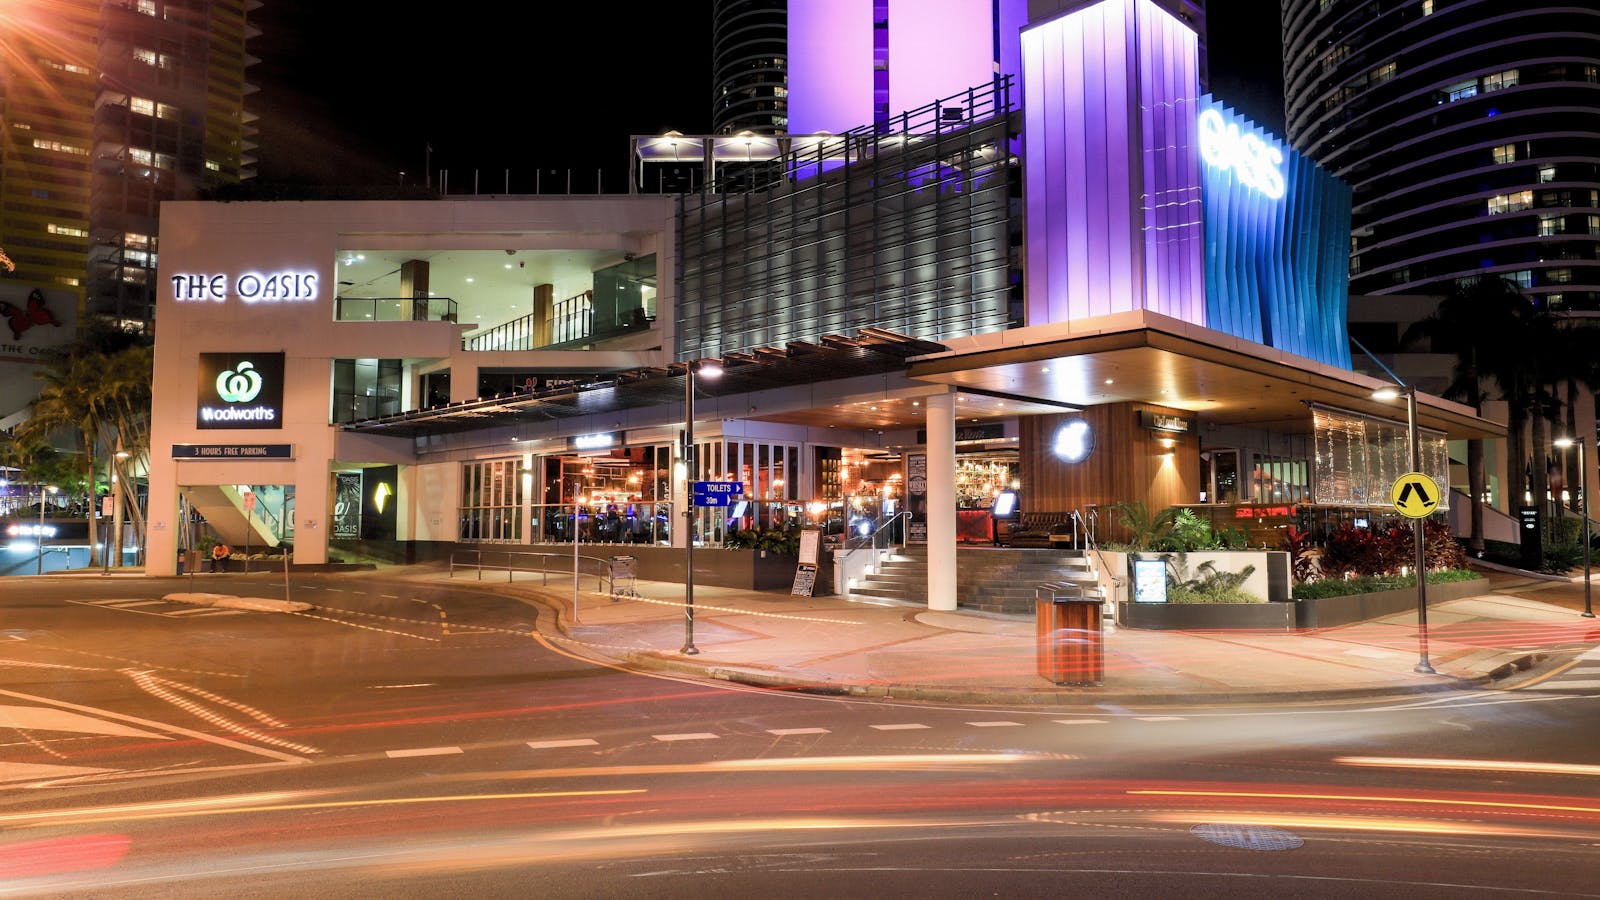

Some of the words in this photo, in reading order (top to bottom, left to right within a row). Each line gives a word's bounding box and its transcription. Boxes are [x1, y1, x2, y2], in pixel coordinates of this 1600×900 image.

[171, 274, 224, 298] THE
[238, 274, 316, 298] OASIS
[202, 406, 274, 421] Woolworths
[194, 447, 199, 456] 3
[201, 447, 222, 456] HOURS
[224, 447, 238, 456] FREE
[240, 447, 267, 456] PARKING
[706, 484, 731, 492] TOILETS
